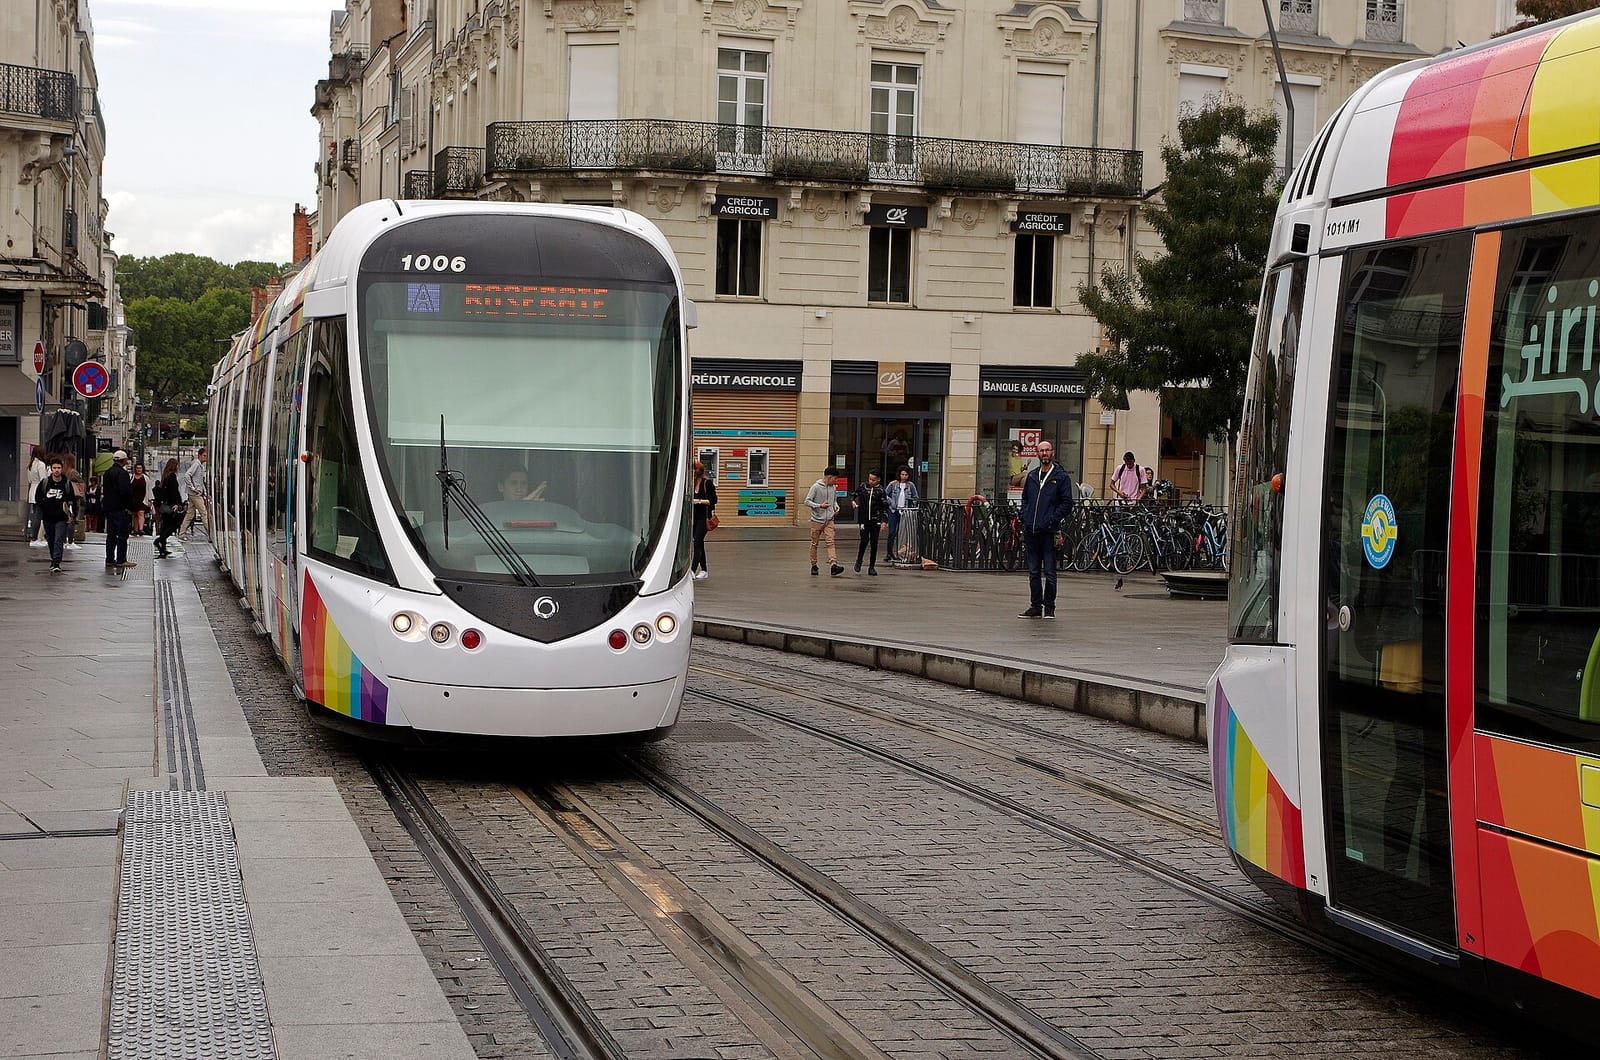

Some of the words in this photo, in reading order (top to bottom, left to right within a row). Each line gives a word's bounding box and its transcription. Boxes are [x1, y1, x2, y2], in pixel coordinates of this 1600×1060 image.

[727, 197, 764, 207] CRÉDIT
[720, 205, 770, 216] AGRICOLE
[1025, 213, 1058, 223] CRÉDIT
[1019, 221, 1064, 231] AGRICOLE
[401, 254, 467, 273] 1006
[34, 353, 43, 363] STOP
[691, 373, 730, 385] RÉDIT
[732, 376, 796, 387] AGRICOLE
[983, 380, 1020, 392] BANQUE
[1021, 383, 1028, 392] &
[1029, 382, 1086, 394] ASSURANCES
